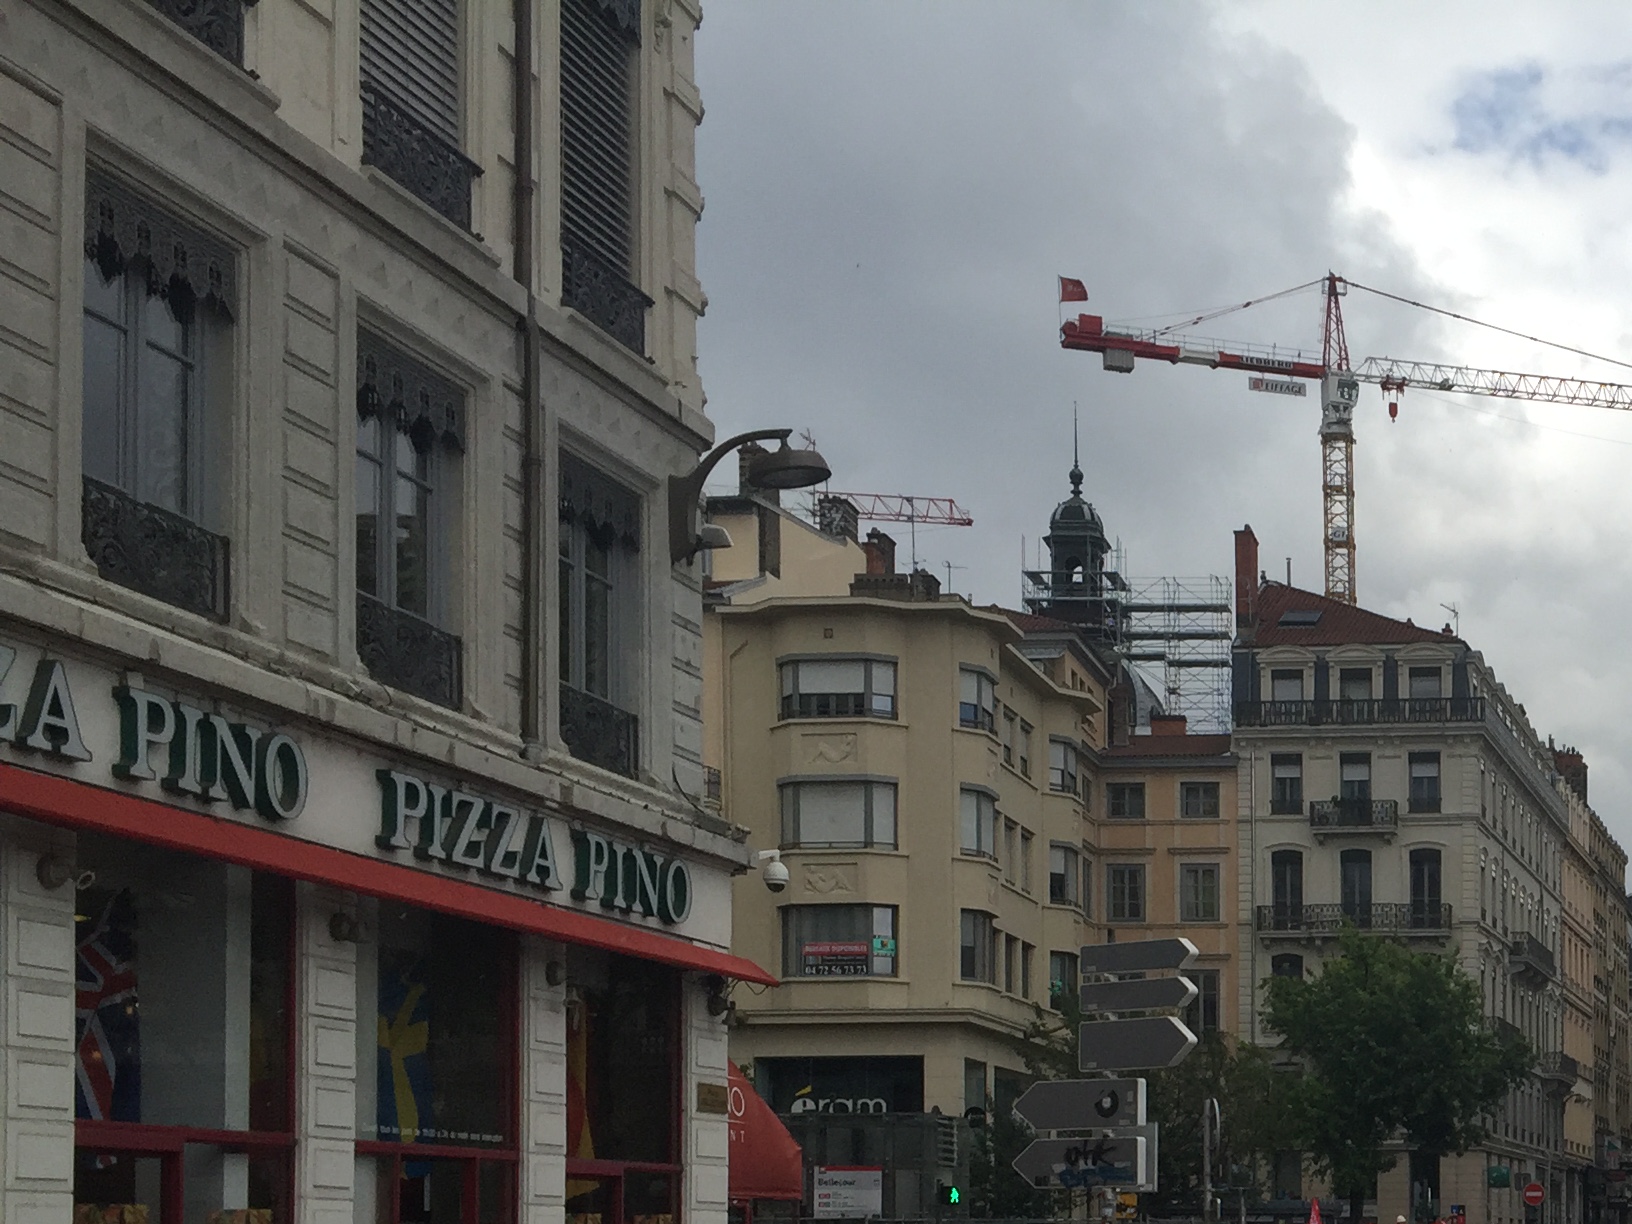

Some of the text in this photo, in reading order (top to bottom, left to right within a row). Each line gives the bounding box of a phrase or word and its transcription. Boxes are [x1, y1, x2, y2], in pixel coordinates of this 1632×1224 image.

[1265, 382, 1303, 395] EIFFAGE
[117, 684, 309, 821] PINO
[380, 768, 694, 926] PIZZA PINO
[805, 965, 816, 975] 04
[818, 965, 829, 975] 72
[844, 965, 855, 975] 73
[857, 965, 867, 975] 73
